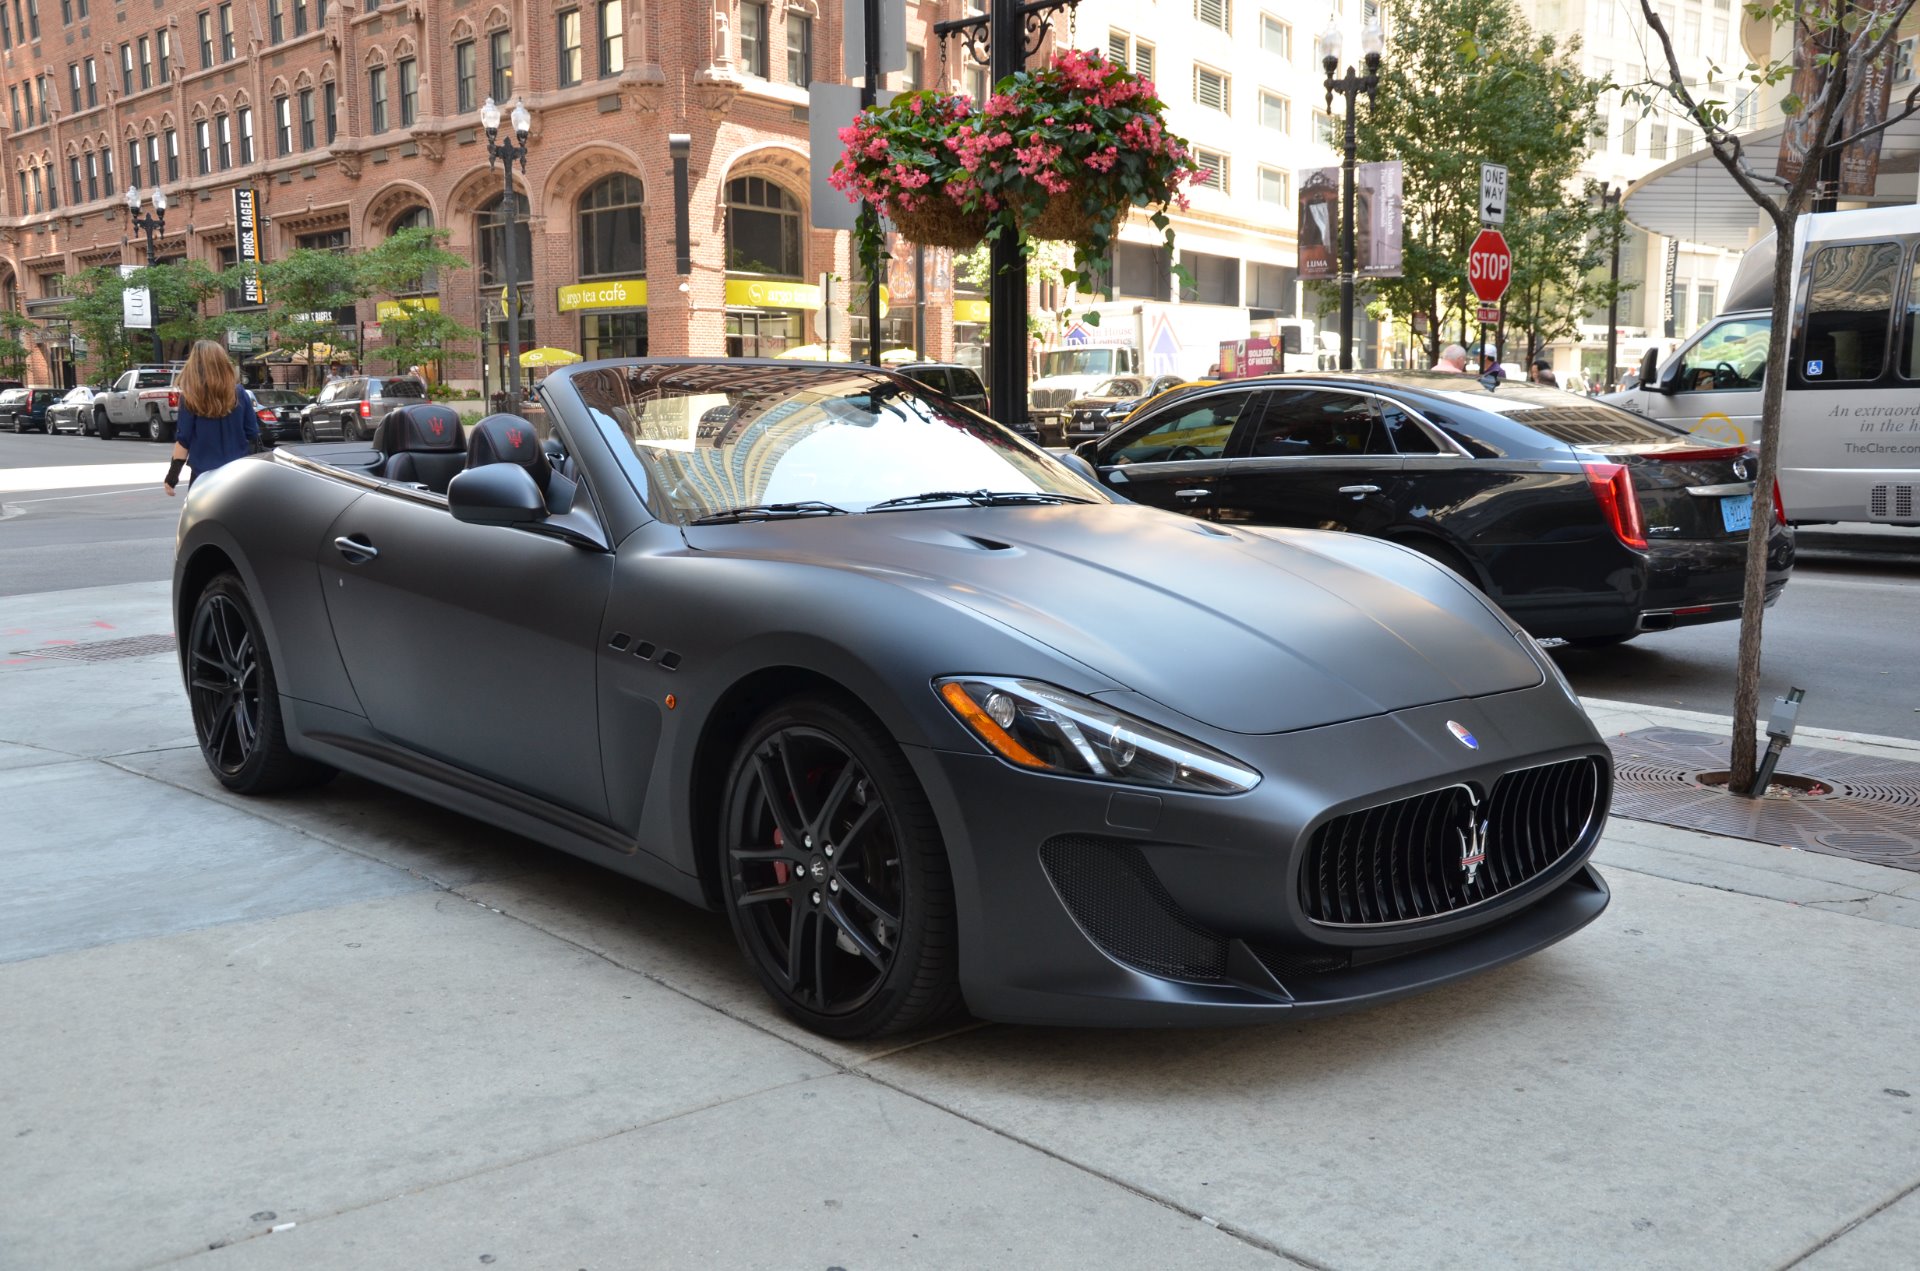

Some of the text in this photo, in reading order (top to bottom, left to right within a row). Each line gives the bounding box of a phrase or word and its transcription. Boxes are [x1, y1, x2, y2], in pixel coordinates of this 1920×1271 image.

[1485, 169, 1504, 185] ONE
[1484, 185, 1504, 200] WAY
[240, 191, 254, 228] BAGELS
[242, 230, 256, 256] BROS.
[1306, 260, 1328, 268] LUMA
[1471, 251, 1509, 281] STOP
[1663, 239, 1677, 322] NORDSTROM rack
[582, 289, 596, 303] tea
[599, 282, 627, 302] café
[767, 289, 793, 306] argo
[1478, 310, 1498, 320] ALL WAY
[1104, 328, 1133, 336] House
[1248, 348, 1274, 358] BOLD SIDE
[1248, 356, 1273, 366] OF WATER
[1828, 404, 1849, 417] An
[1860, 419, 1874, 432] in
[1880, 418, 1904, 432] the
